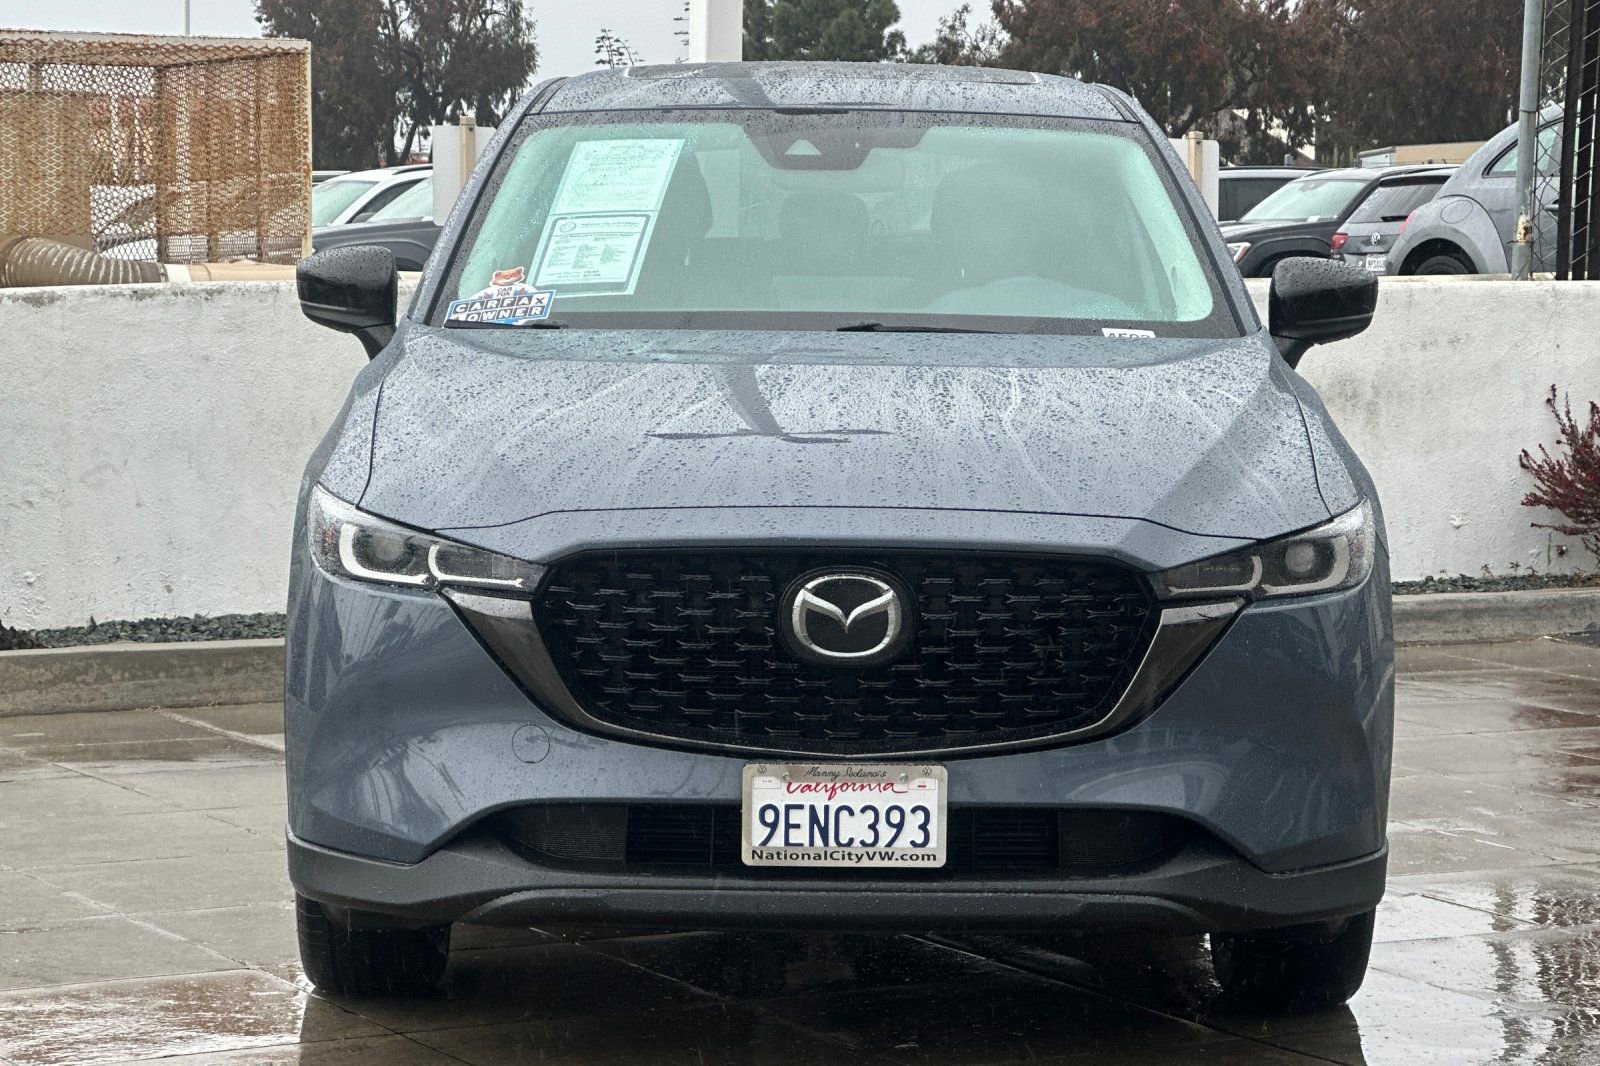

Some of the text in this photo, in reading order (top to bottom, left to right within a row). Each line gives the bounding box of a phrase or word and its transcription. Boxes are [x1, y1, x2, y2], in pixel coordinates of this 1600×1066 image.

[455, 297, 547, 314] CARFAX
[466, 306, 543, 323] OWNER
[804, 766, 841, 780] Manny
[786, 782, 909, 800] California
[758, 803, 931, 848] 9ENC393
[751, 849, 937, 863] NationalCityVW.com
